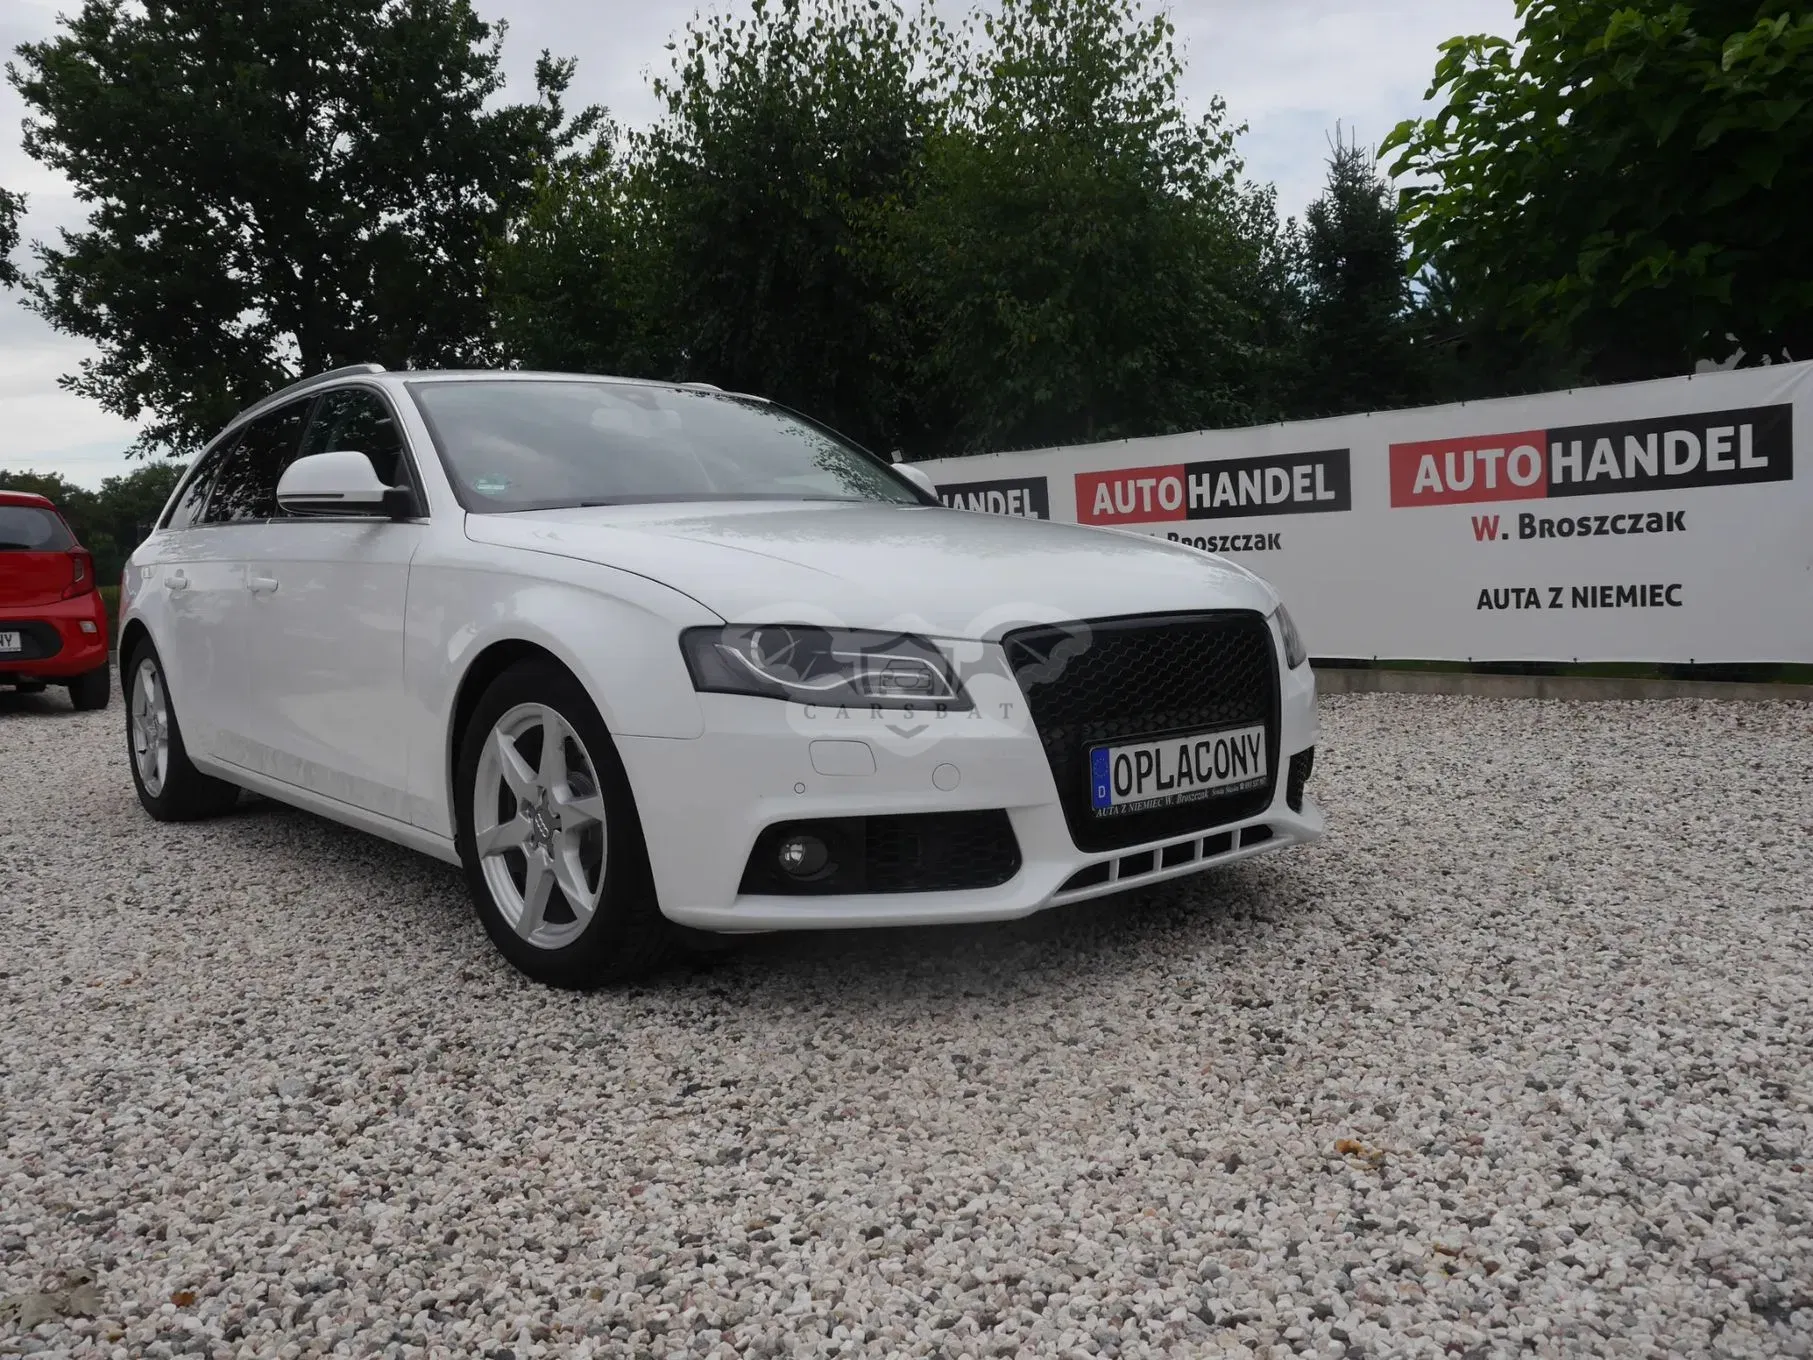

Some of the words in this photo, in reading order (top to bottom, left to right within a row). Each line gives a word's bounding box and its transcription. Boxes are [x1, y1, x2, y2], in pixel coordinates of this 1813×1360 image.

[1471, 515, 1509, 541] W.
[1477, 587, 1541, 610] AUTA
[1548, 587, 1564, 609] Z
[1571, 583, 1683, 608] NIEMIEC
[1113, 732, 1261, 797] OPLACONY
[1098, 785, 1106, 799] D
[1096, 805, 1119, 818] AUTA
[1129, 798, 1163, 813] NIEMIEC
